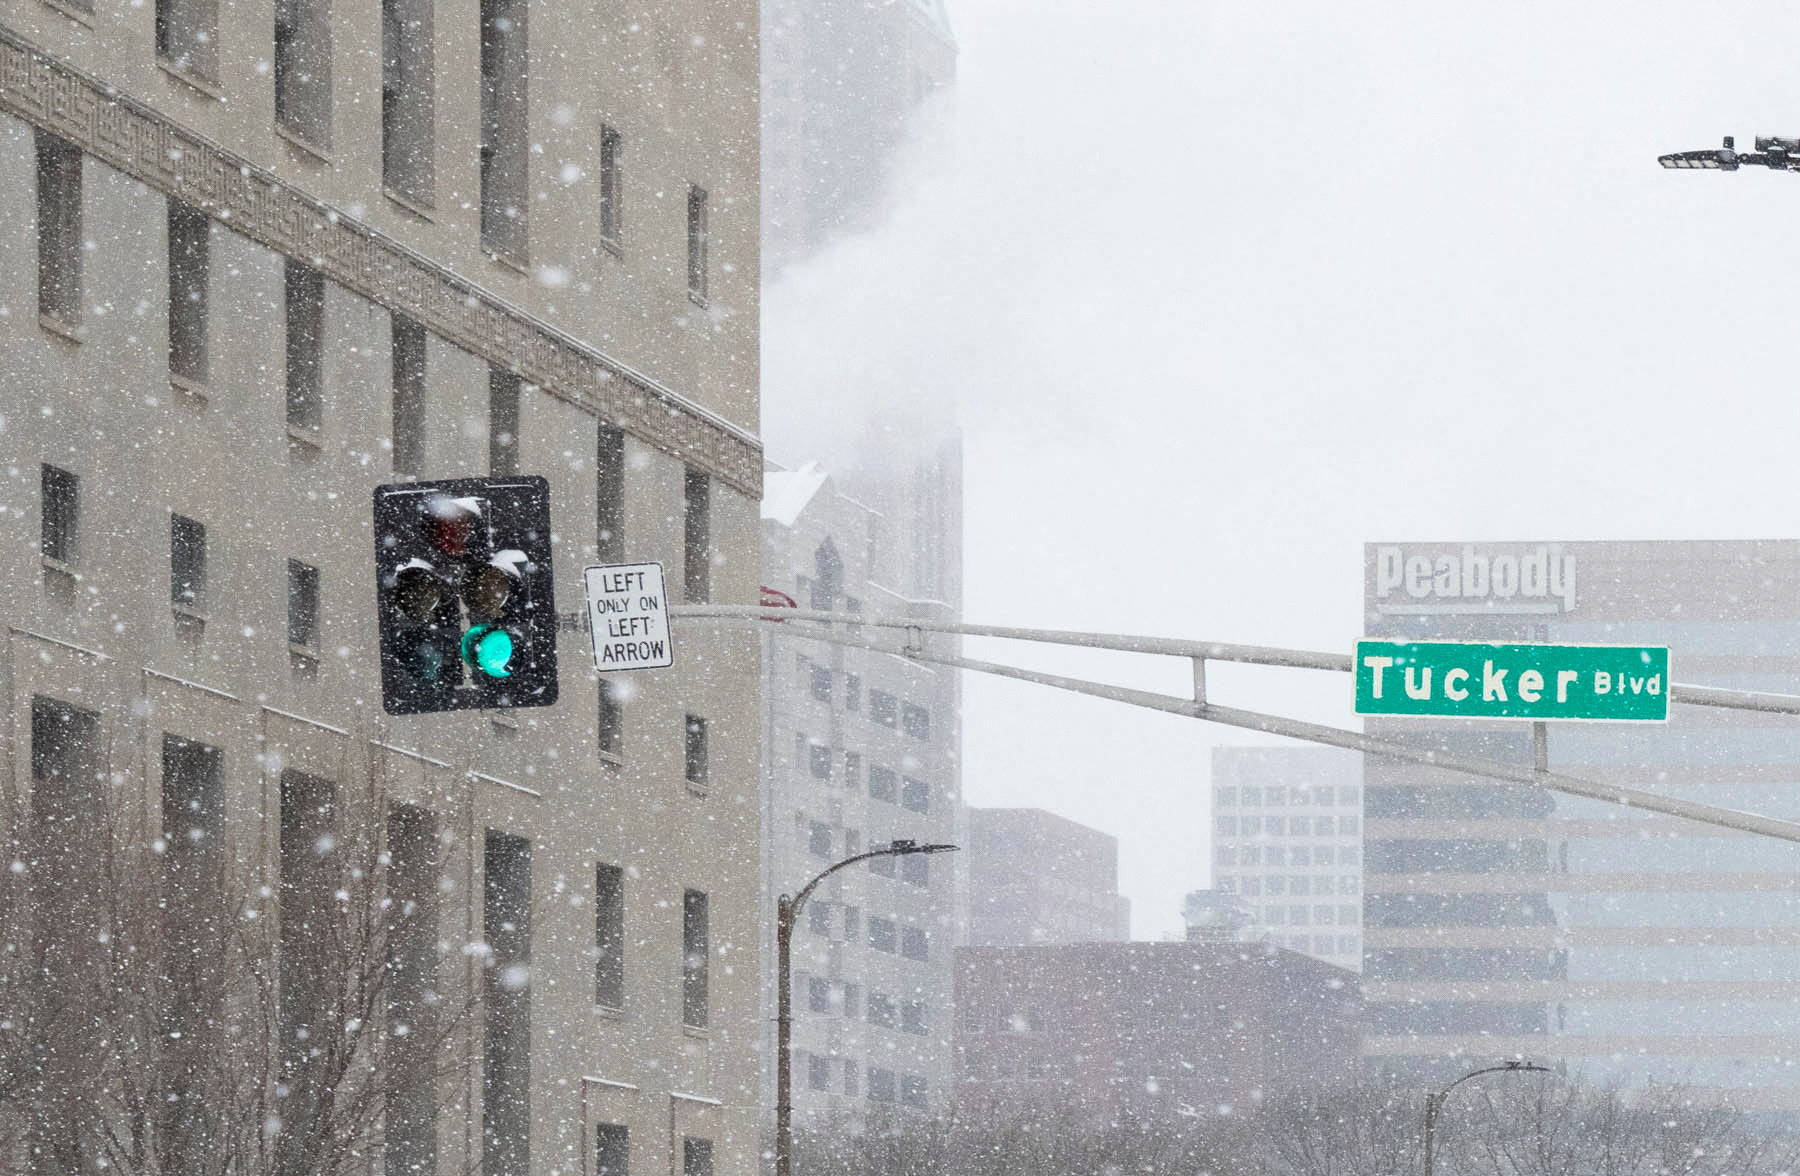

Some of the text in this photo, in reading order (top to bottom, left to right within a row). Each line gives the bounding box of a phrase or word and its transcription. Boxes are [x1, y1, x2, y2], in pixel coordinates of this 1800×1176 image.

[603, 572, 645, 593] LEFT
[1377, 543, 1576, 612] Peabody
[597, 596, 658, 614] ONLY ON
[608, 616, 650, 637] LEFT
[602, 640, 664, 662] ARROW
[1363, 655, 1661, 703] Tucker Blvd
